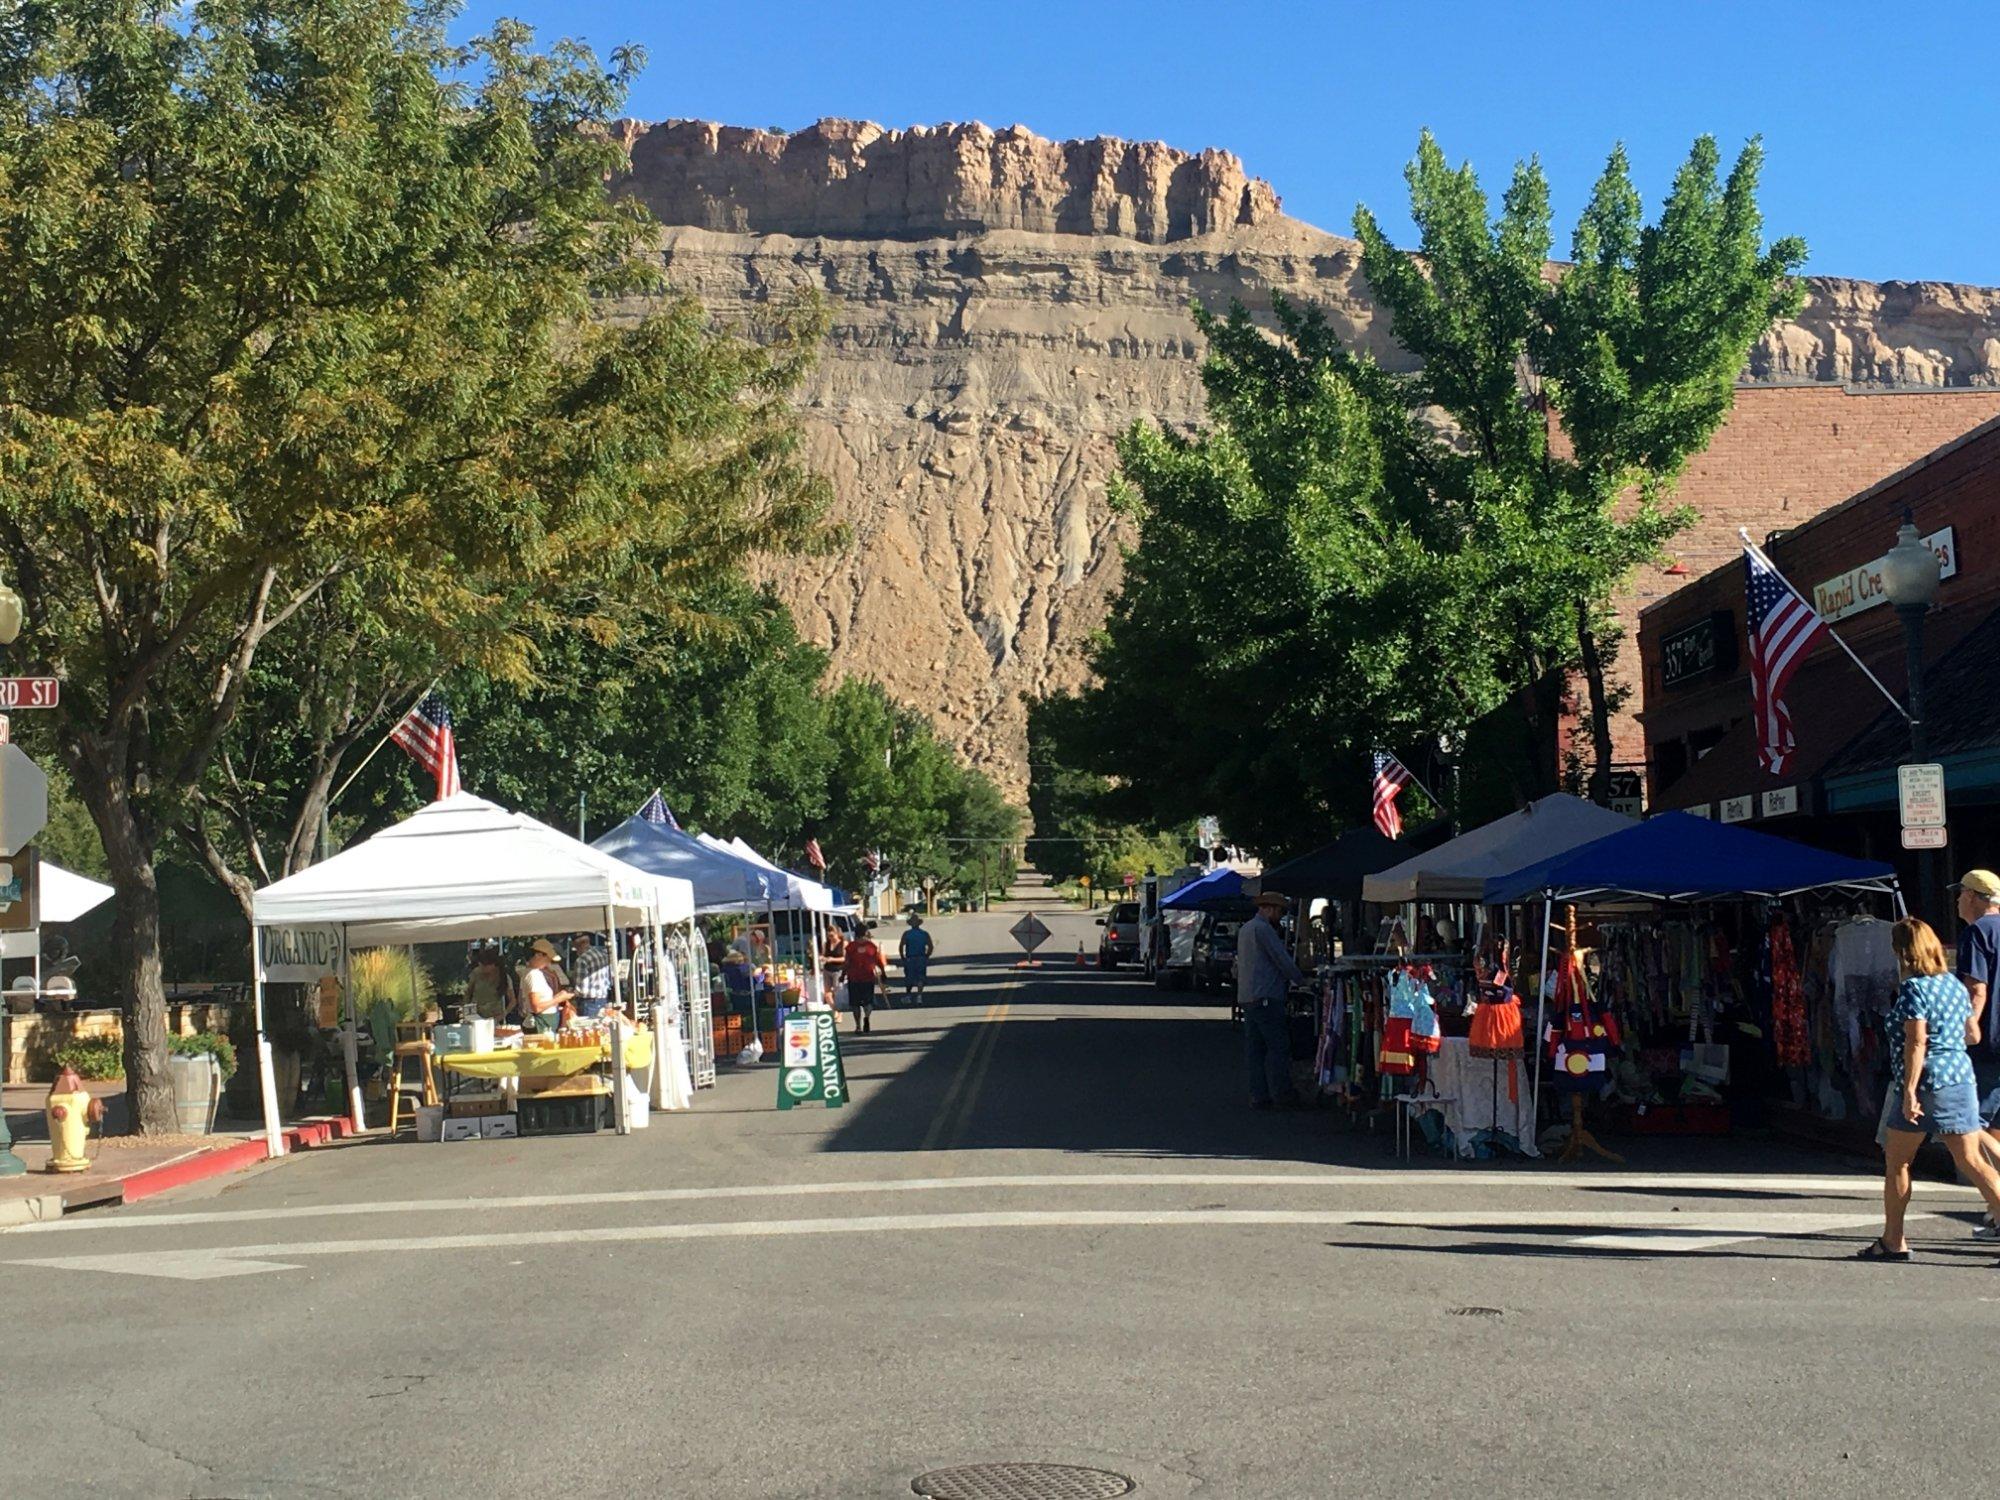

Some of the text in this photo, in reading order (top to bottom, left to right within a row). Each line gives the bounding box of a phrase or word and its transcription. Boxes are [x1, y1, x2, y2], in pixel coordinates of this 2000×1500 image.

[1817, 569, 1884, 618] Rapid Cre
[31, 681, 53, 705] ST
[1607, 775, 1636, 798] 57
[264, 924, 329, 968] ORGANIC
[817, 1013, 840, 1099] ORGANIC
